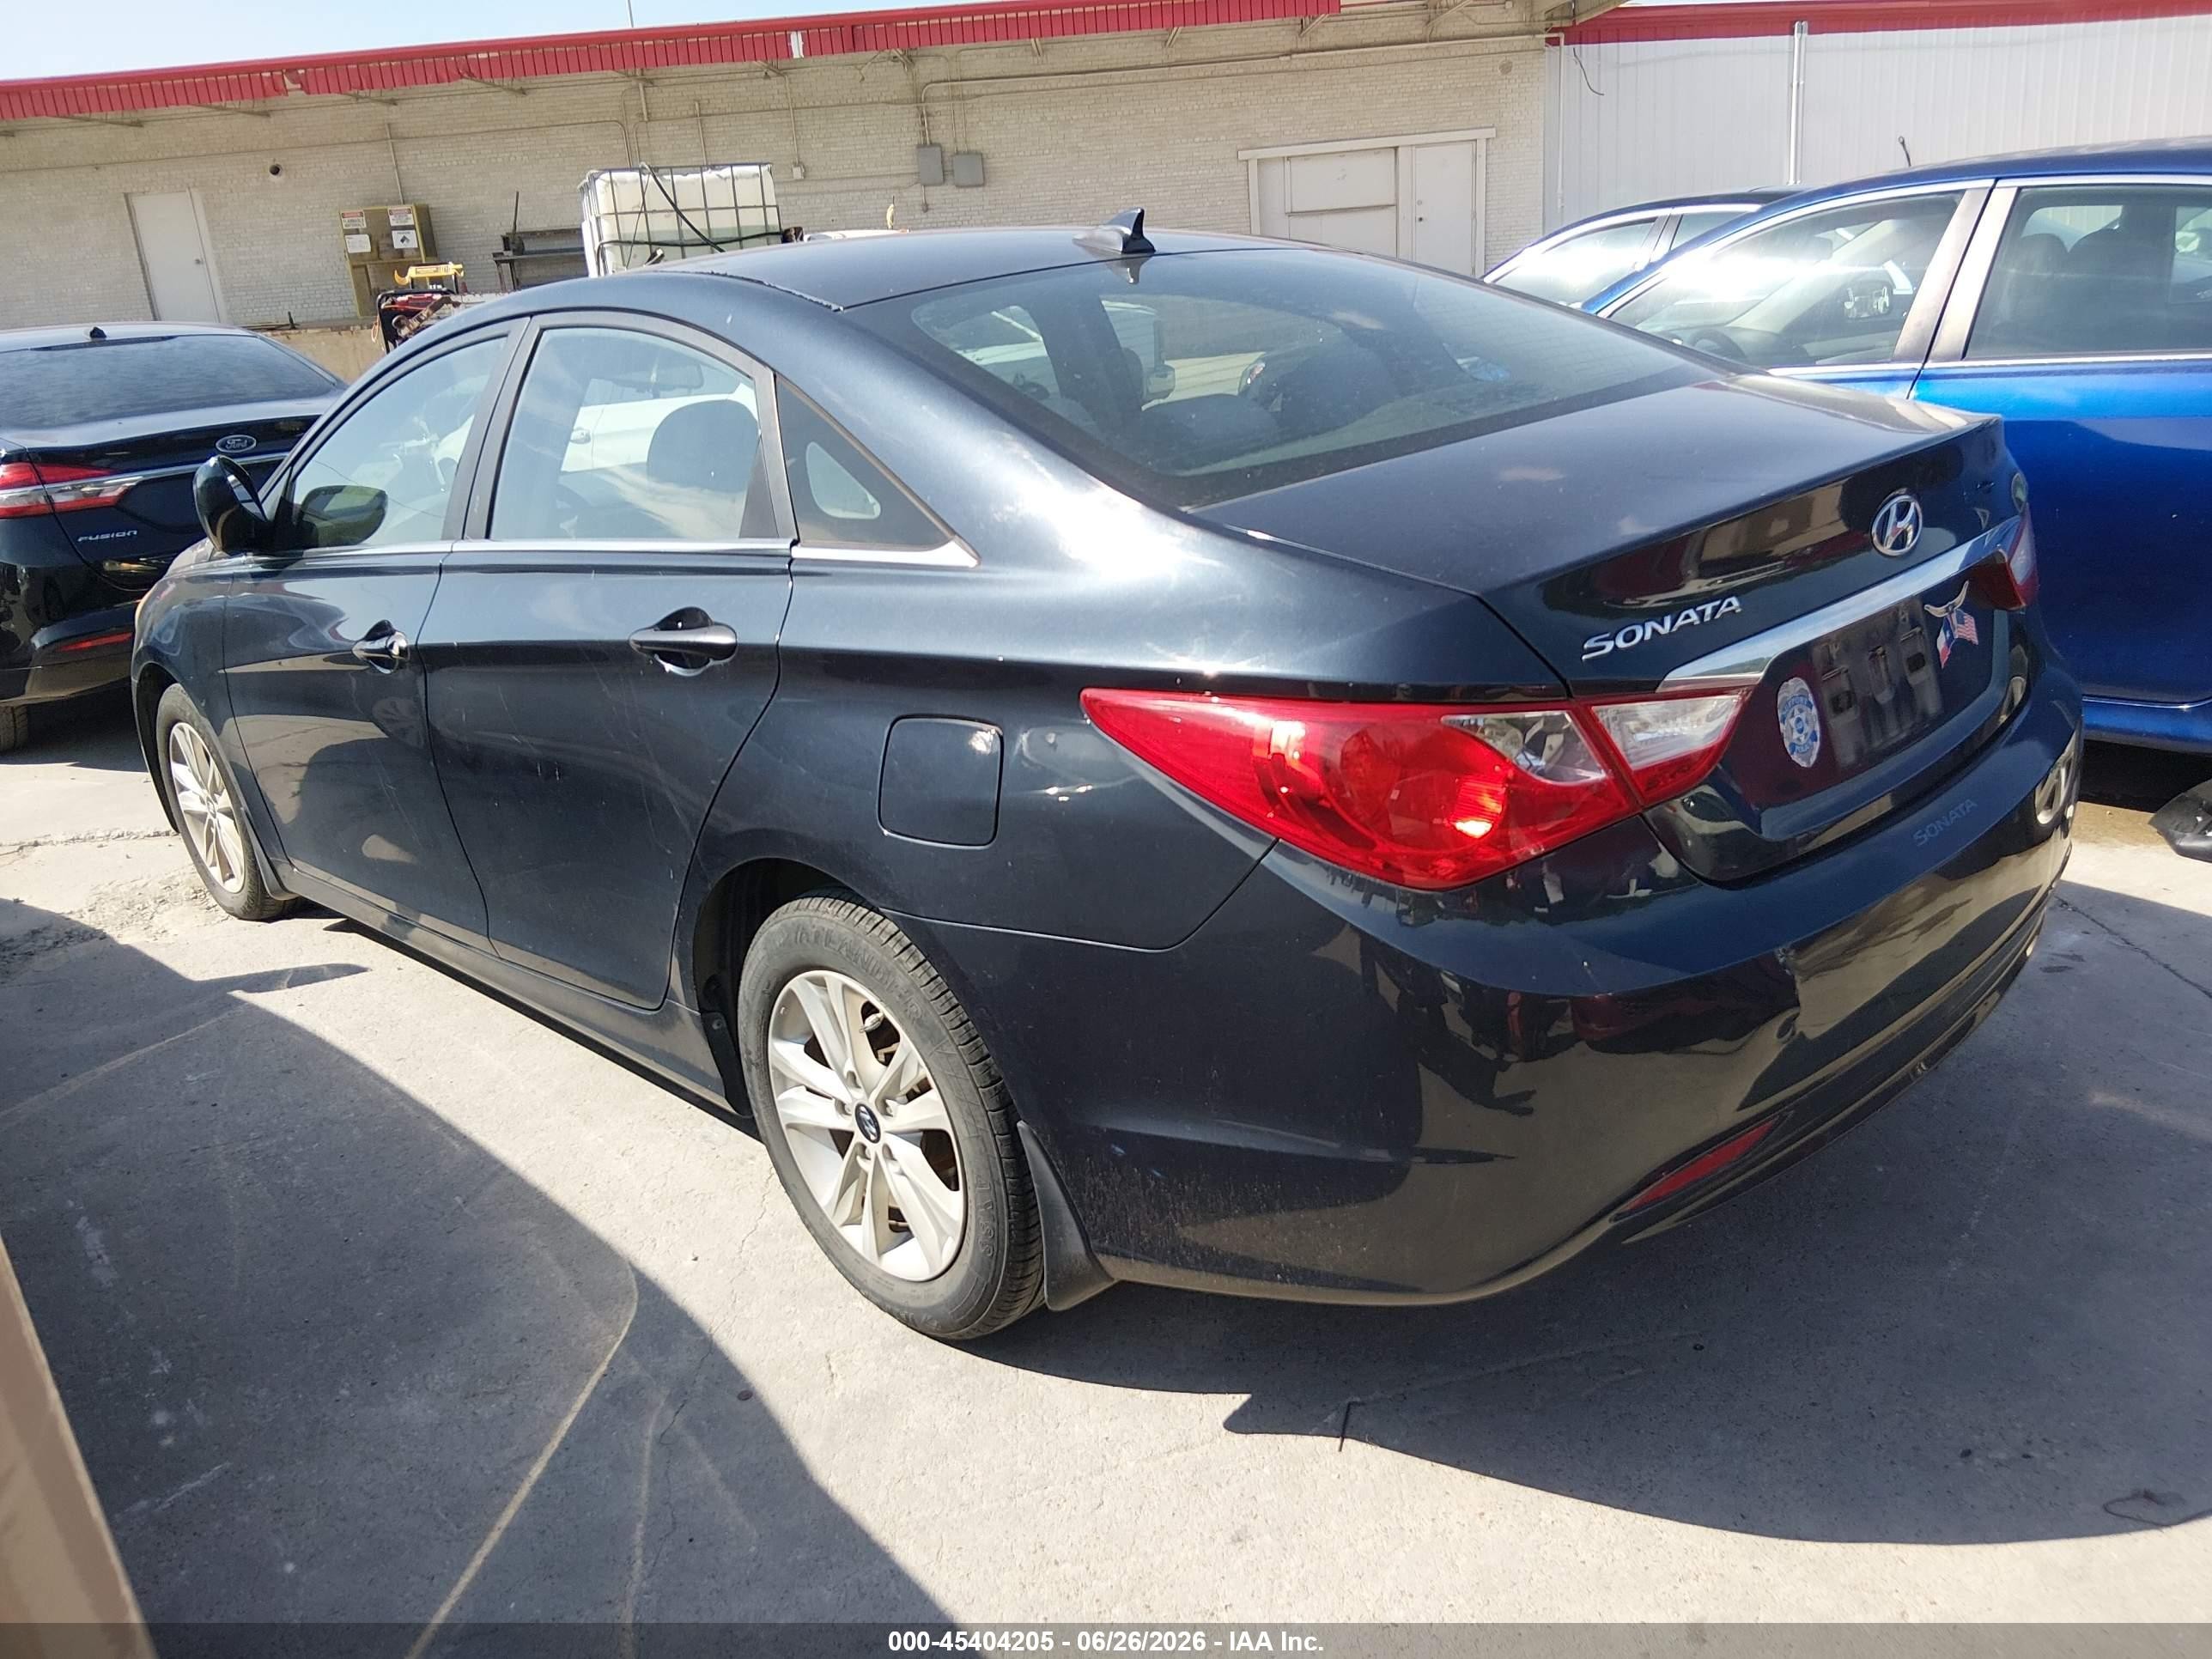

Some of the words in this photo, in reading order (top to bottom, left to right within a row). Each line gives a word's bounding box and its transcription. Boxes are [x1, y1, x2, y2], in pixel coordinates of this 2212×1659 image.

[225, 437, 249, 451] Ford
[77, 529, 138, 543] FUSION
[1581, 595, 1743, 662] SONATA
[1912, 798, 1978, 848] SONATA
